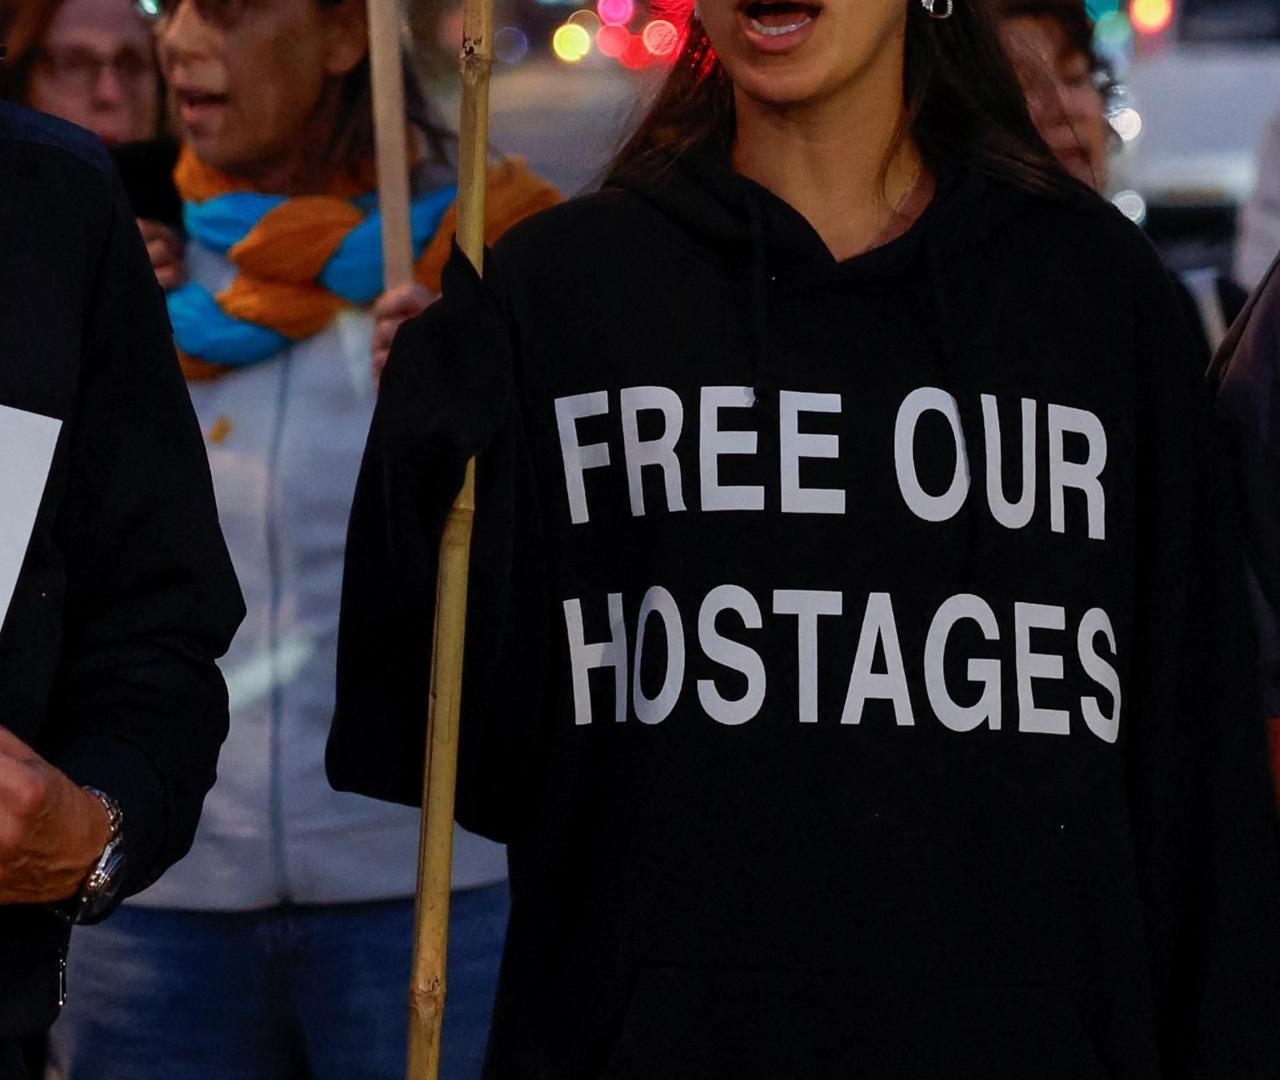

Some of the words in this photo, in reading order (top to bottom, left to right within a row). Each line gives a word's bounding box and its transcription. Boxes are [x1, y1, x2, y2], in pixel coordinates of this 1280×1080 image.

[554, 385, 847, 524] FREE
[894, 386, 1107, 540] OUR
[562, 584, 1121, 743] HOSTAGES
